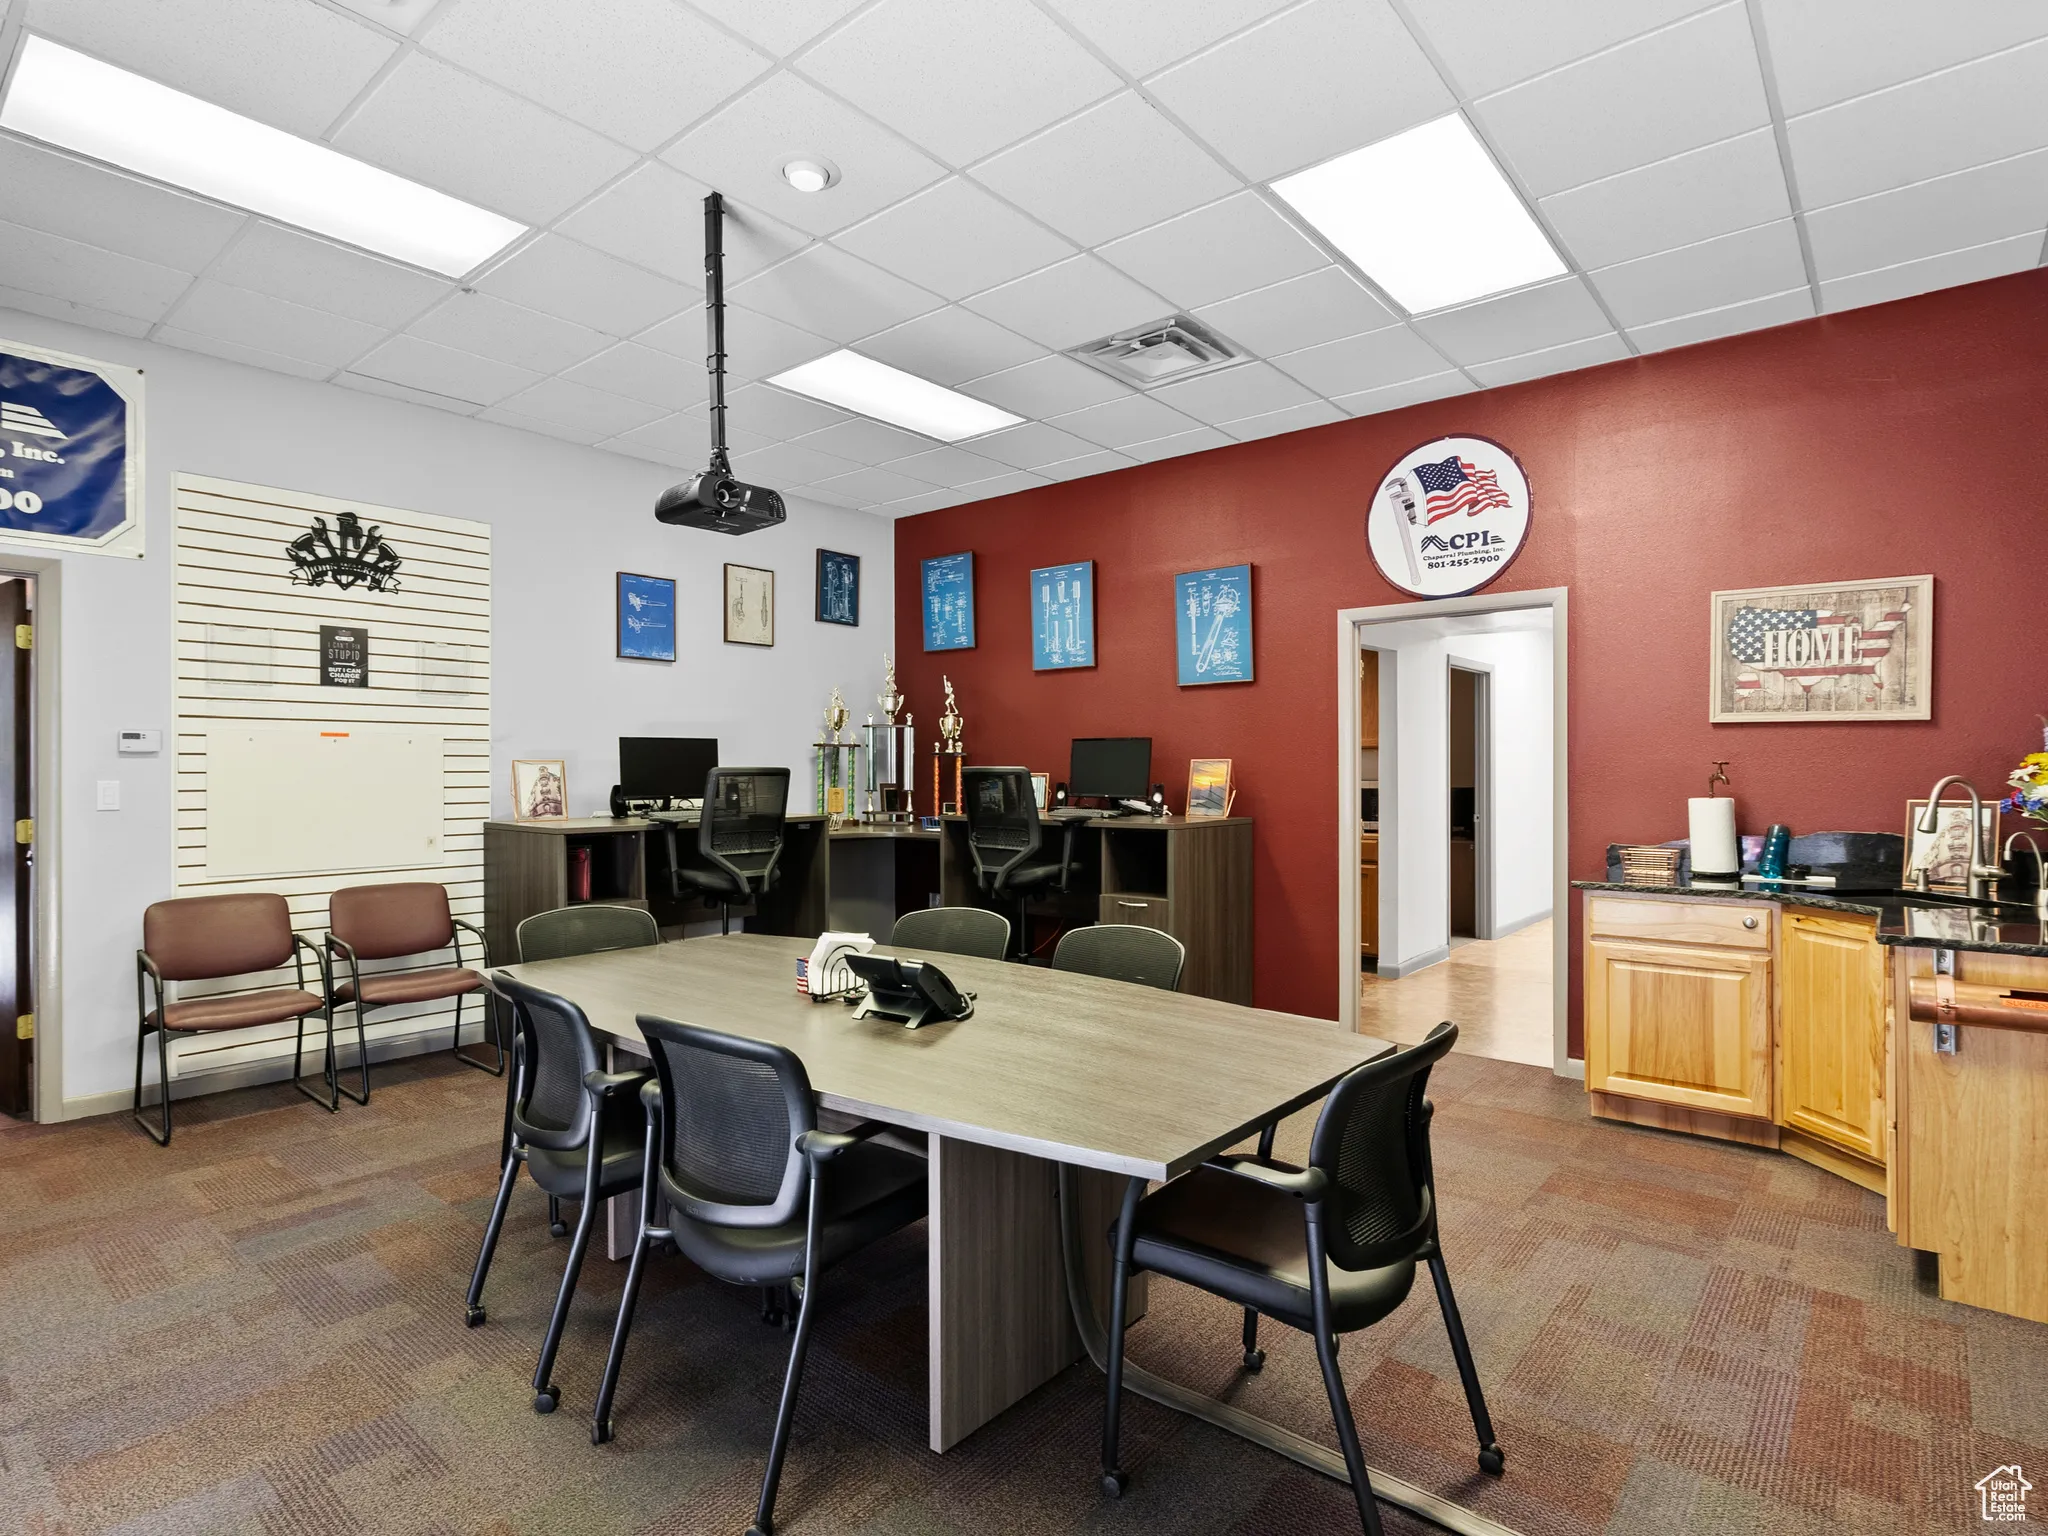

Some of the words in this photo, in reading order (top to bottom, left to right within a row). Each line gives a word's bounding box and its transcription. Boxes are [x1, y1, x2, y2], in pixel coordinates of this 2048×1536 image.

[11, 441, 65, 465] Inc.
[1449, 530, 1490, 550] CPI
[1422, 552, 1456, 561] Chaparral
[1457, 549, 1492, 557] Plumbing,
[1427, 555, 1500, 570] 801-255-2900
[328, 648, 361, 661] STUPID
[1763, 626, 1863, 669] HOME
